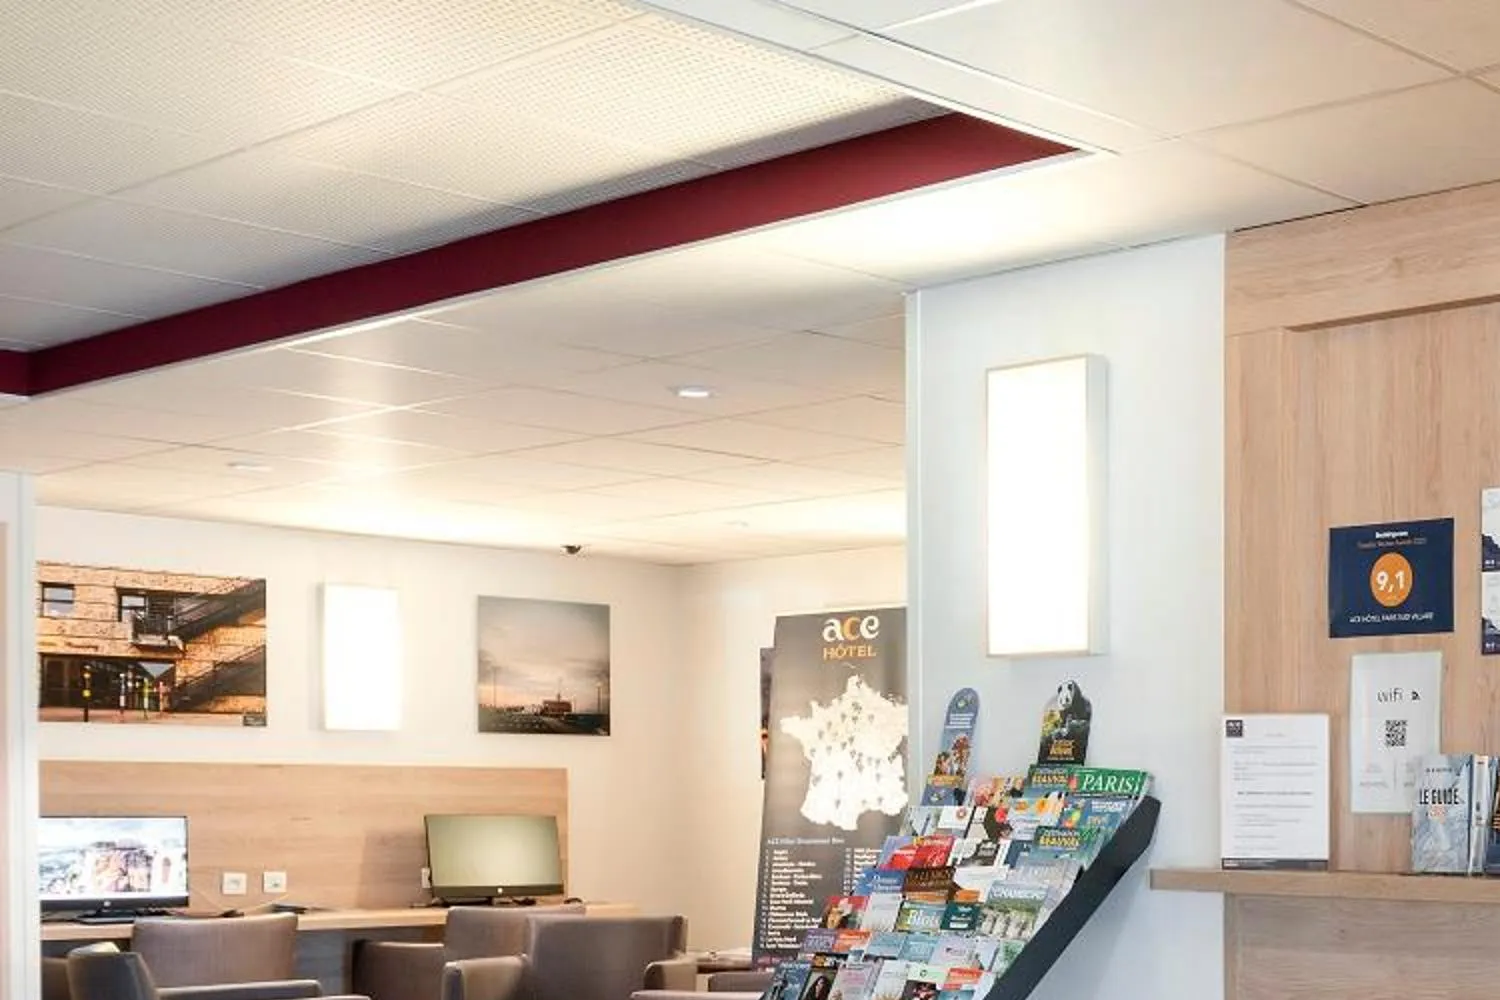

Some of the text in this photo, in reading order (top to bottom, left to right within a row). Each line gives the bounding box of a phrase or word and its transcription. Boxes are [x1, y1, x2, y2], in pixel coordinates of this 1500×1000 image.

[1376, 571, 1405, 593] 9,1
[822, 615, 879, 642] ace
[823, 643, 876, 660] HÔTEL
[1431, 788, 1459, 805] GUIDE
